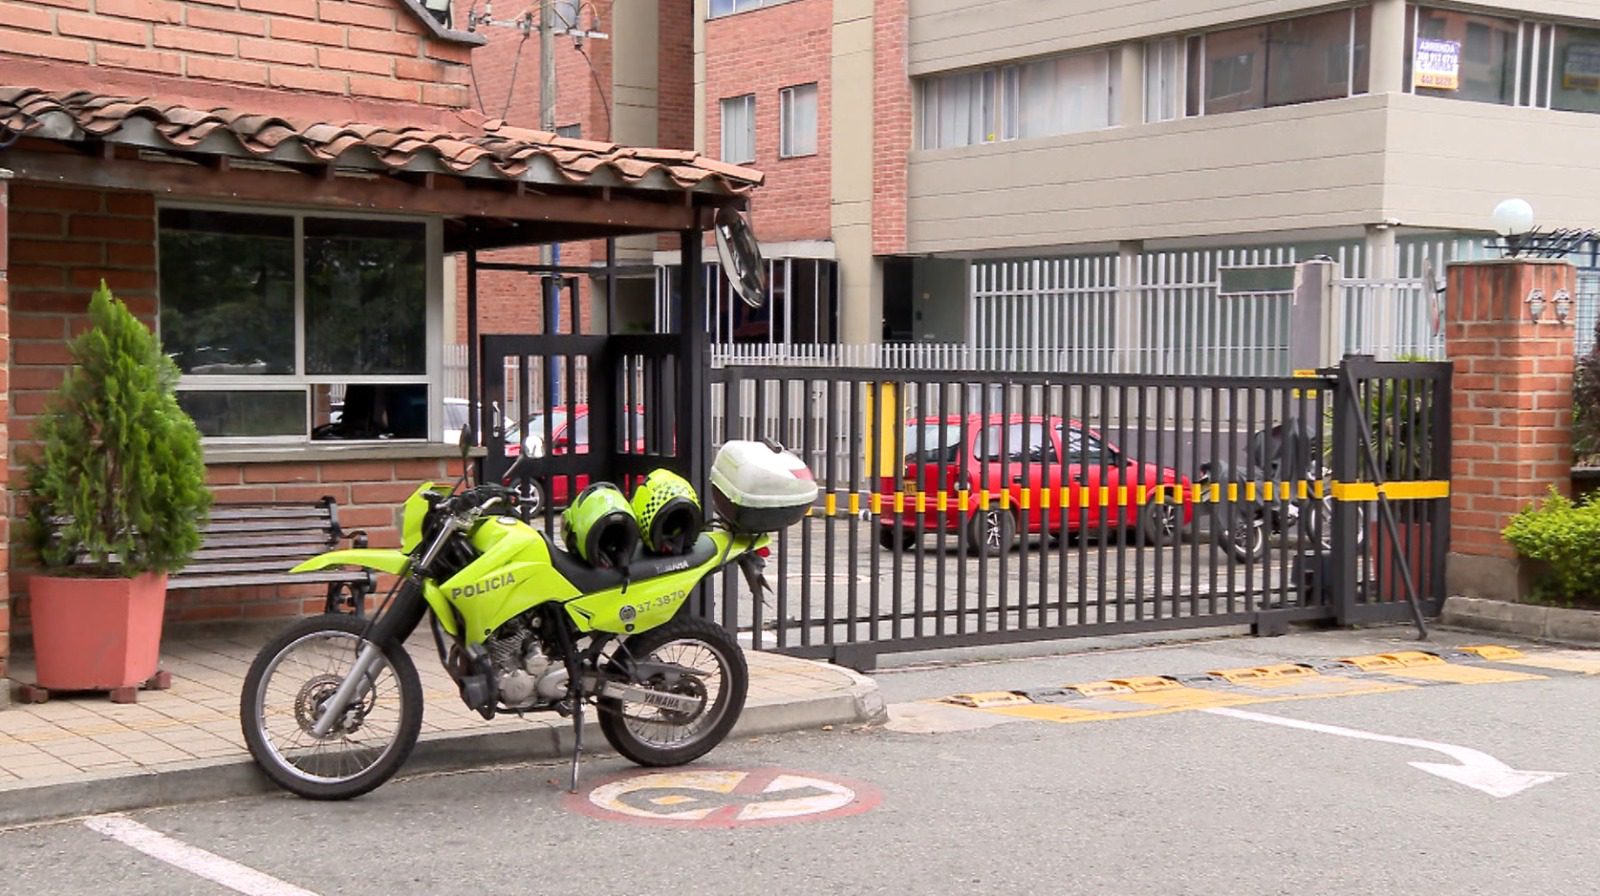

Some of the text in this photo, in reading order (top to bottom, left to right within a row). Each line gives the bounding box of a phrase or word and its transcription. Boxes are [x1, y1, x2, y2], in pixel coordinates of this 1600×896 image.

[451, 572, 515, 600] POLICIA
[636, 590, 686, 613] 37-3870
[644, 693, 680, 709] YAMAHA
